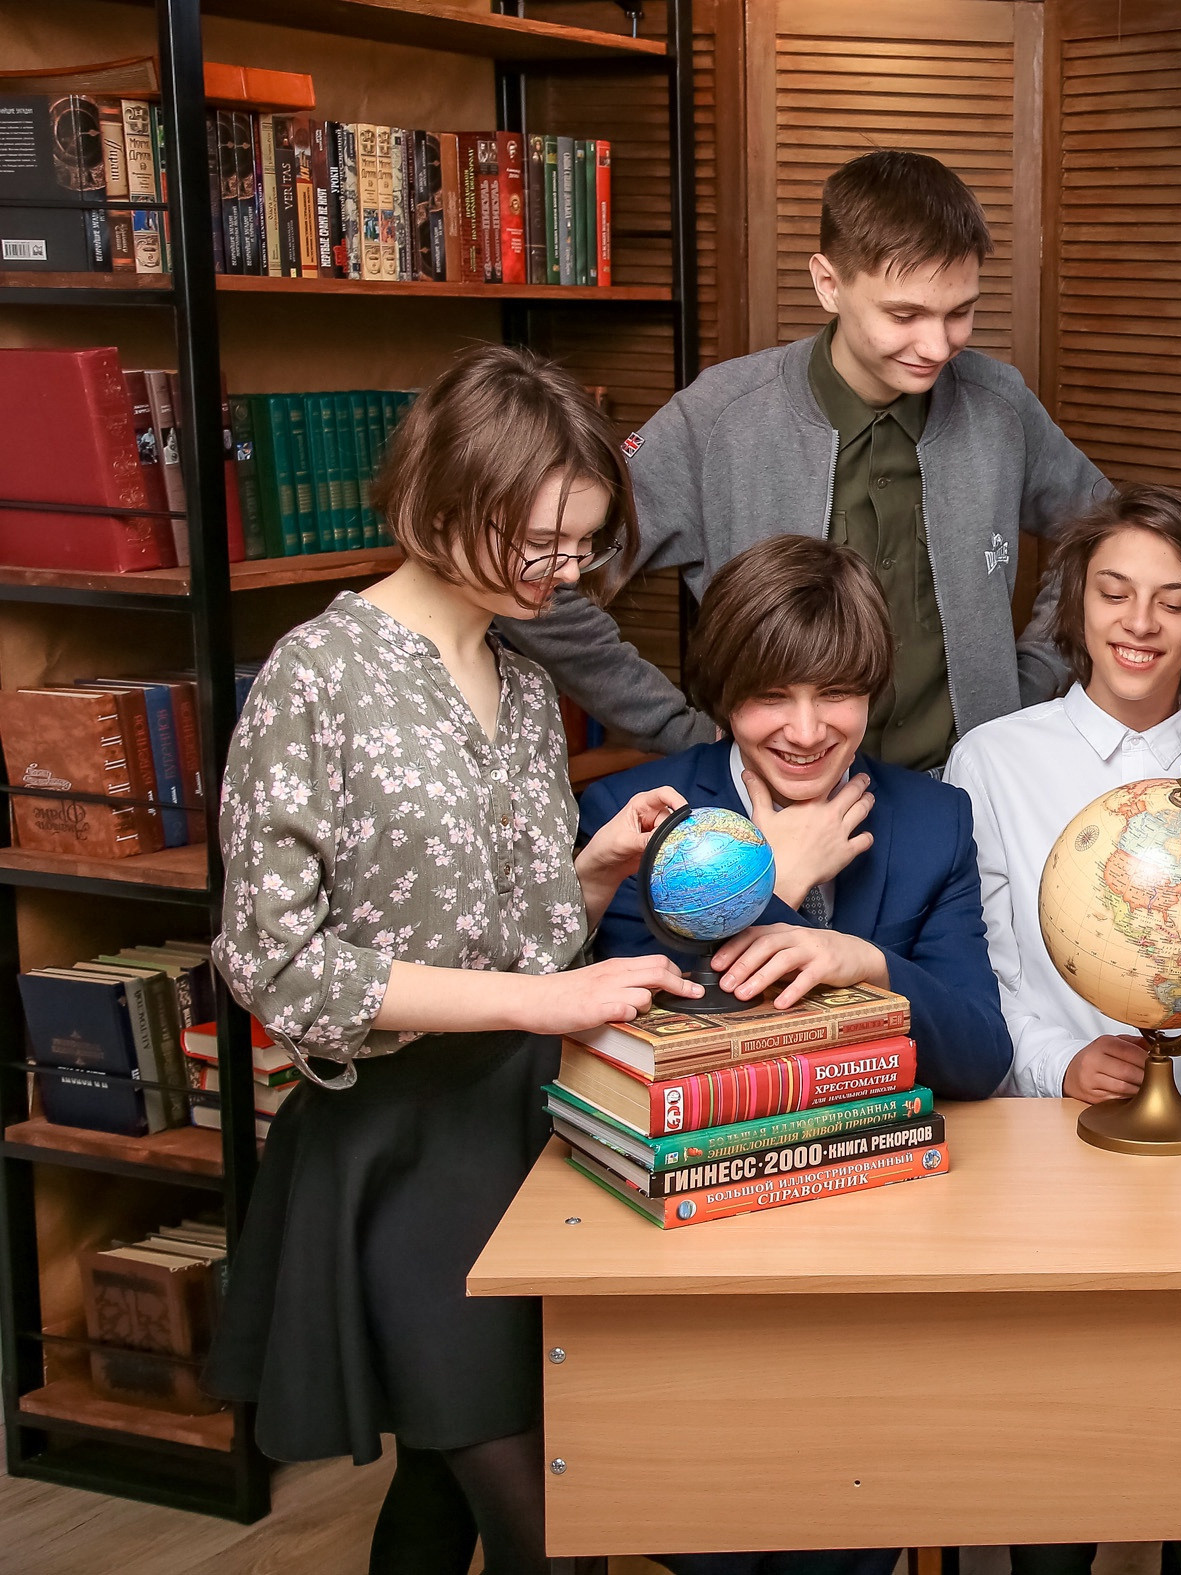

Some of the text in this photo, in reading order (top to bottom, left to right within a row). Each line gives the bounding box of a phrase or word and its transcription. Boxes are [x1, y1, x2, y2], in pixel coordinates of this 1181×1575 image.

[280, 163, 294, 210] VERITAS
[330, 166, 340, 194] УРОКИ
[317, 188, 331, 267] МЕРТВЫЕ СРАМУ НЕ ИМУТ
[743, 1028, 824, 1051] МОНАРХИ РОССИИ
[814, 1054, 900, 1080] БОЛЬШАЯ
[814, 1072, 898, 1095] ХРЕСТОМАТИЯ
[811, 1084, 897, 1105] ДЛЯ НАЧАЛЬНОЙ ШКОЛЫ
[707, 1111, 898, 1160] ЭНЦИКЛОПЕДИЯ ЖИВОЙ ПРИРОДЫ
[708, 1100, 897, 1149] БОЛЬШАЯ ИЛЛЮСТРИРОВАННАЯ
[663, 1125, 933, 1194] ГИННЕСС 2000 КНИГА РЕКОРДОВ
[706, 1152, 914, 1204] БОЛЬШОЙ ИЛЛЮСТРИРОВАННЫЙ
[757, 1173, 870, 1206] СПРАВОЧНИК
